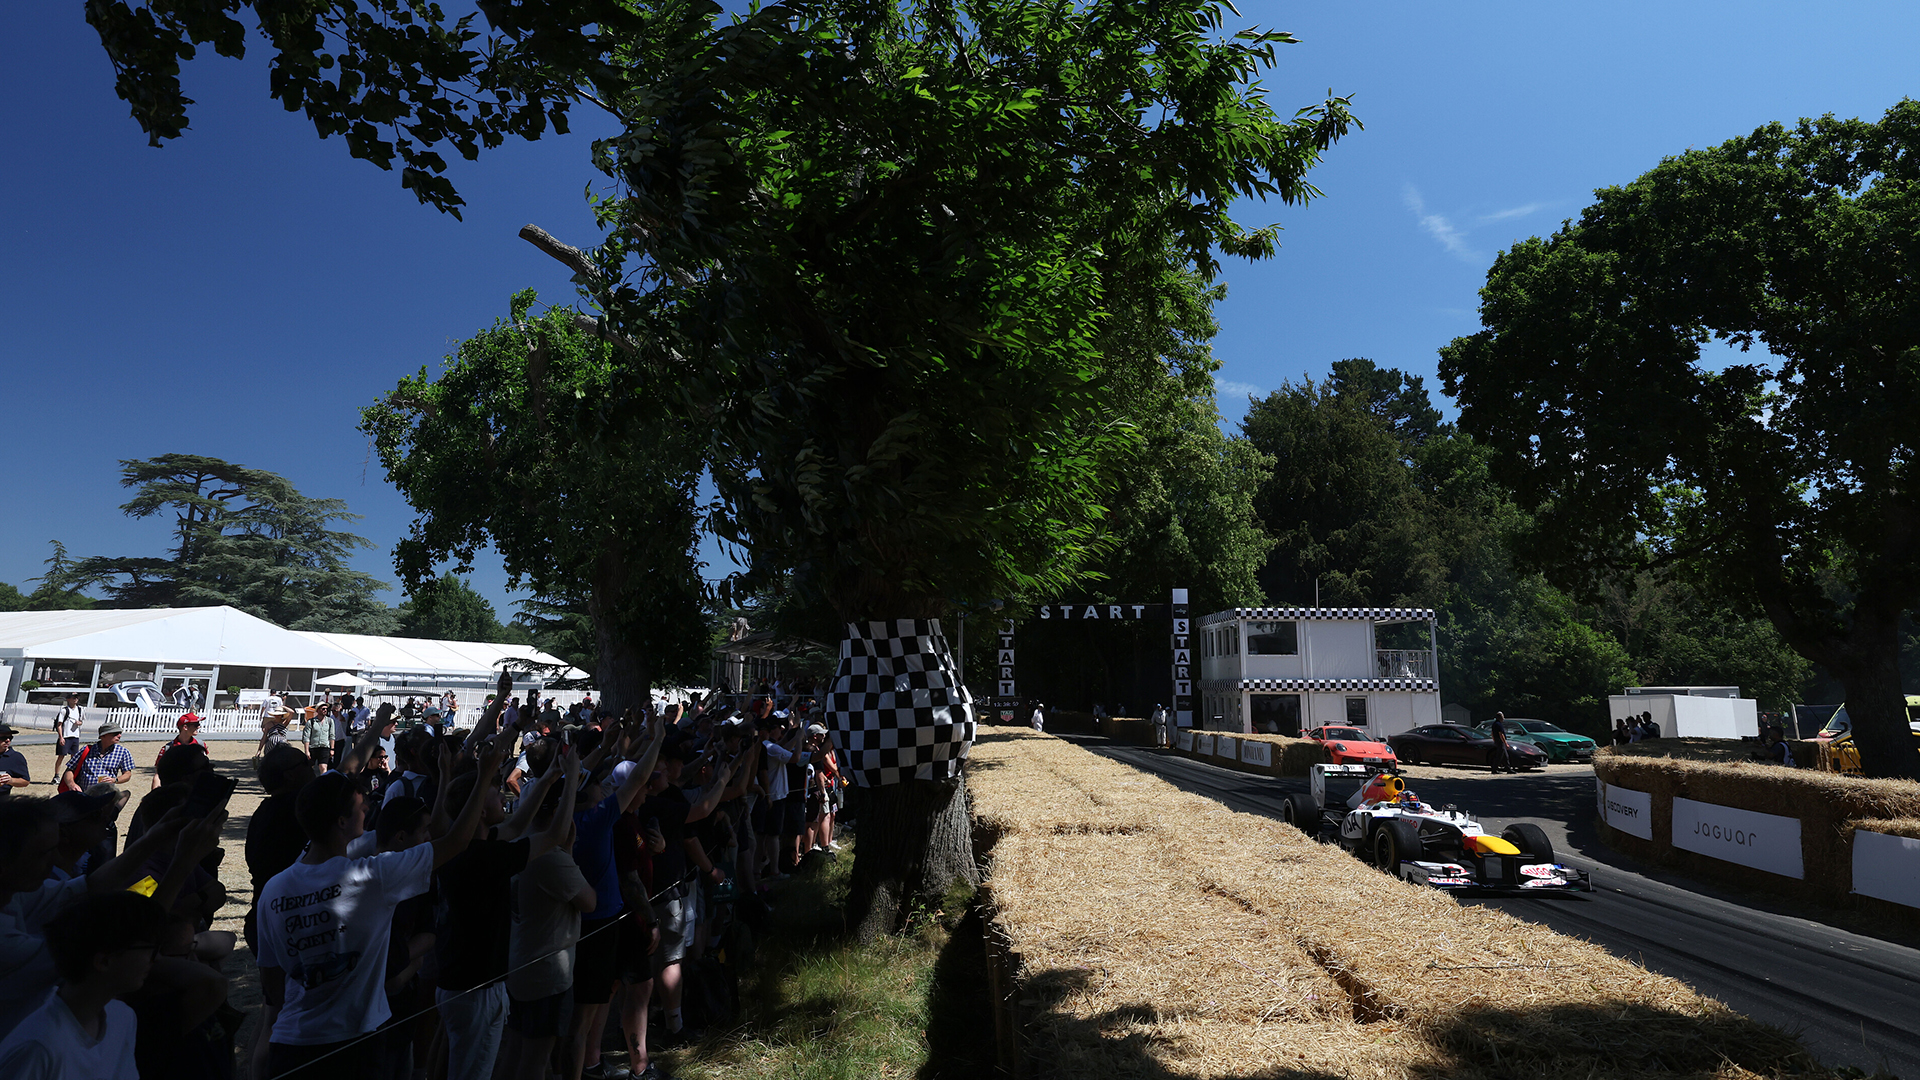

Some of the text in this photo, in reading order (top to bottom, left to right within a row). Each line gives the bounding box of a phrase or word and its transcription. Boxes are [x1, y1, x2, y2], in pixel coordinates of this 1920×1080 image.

[1040, 605, 1146, 620] START
[1177, 621, 1190, 694] START
[1607, 800, 1639, 818] DISCOVERY
[271, 884, 342, 914] HERITAGE
[286, 911, 330, 934] AUTO
